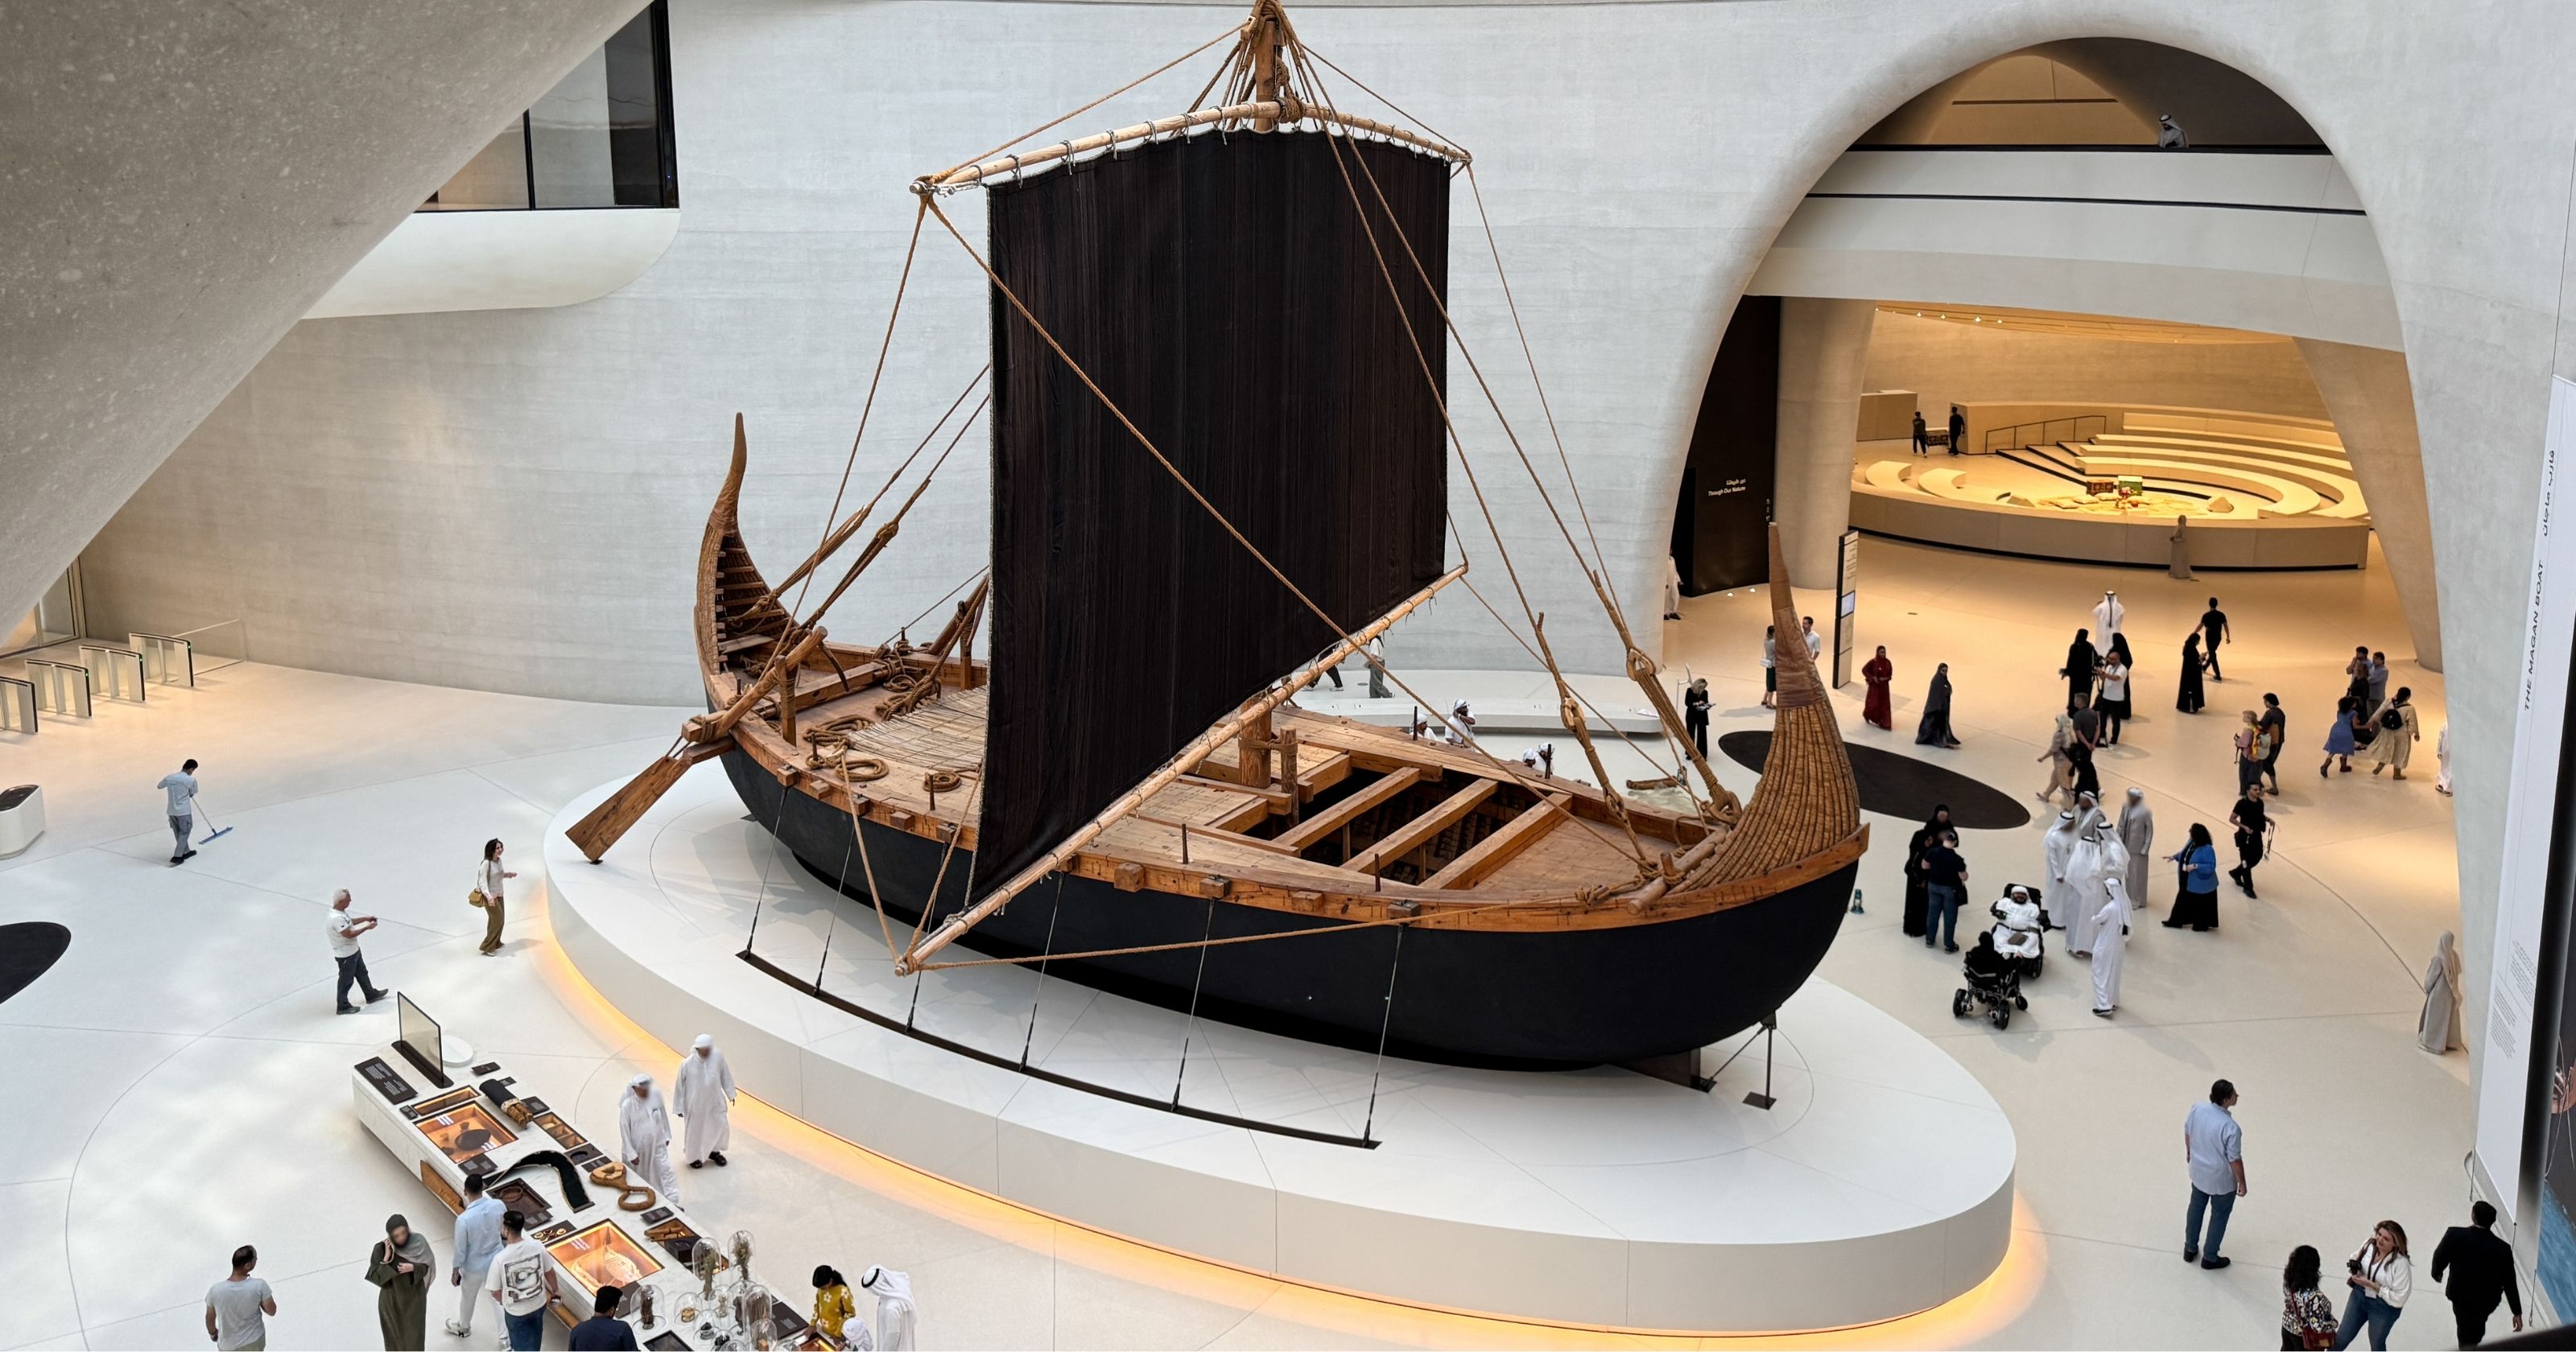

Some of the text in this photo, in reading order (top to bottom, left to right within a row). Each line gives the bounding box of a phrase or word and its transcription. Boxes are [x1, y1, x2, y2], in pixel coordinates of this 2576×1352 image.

[2542, 450, 2555, 538] قارب ماجان
[2524, 559, 2544, 711] THE MAGAN BOAT
